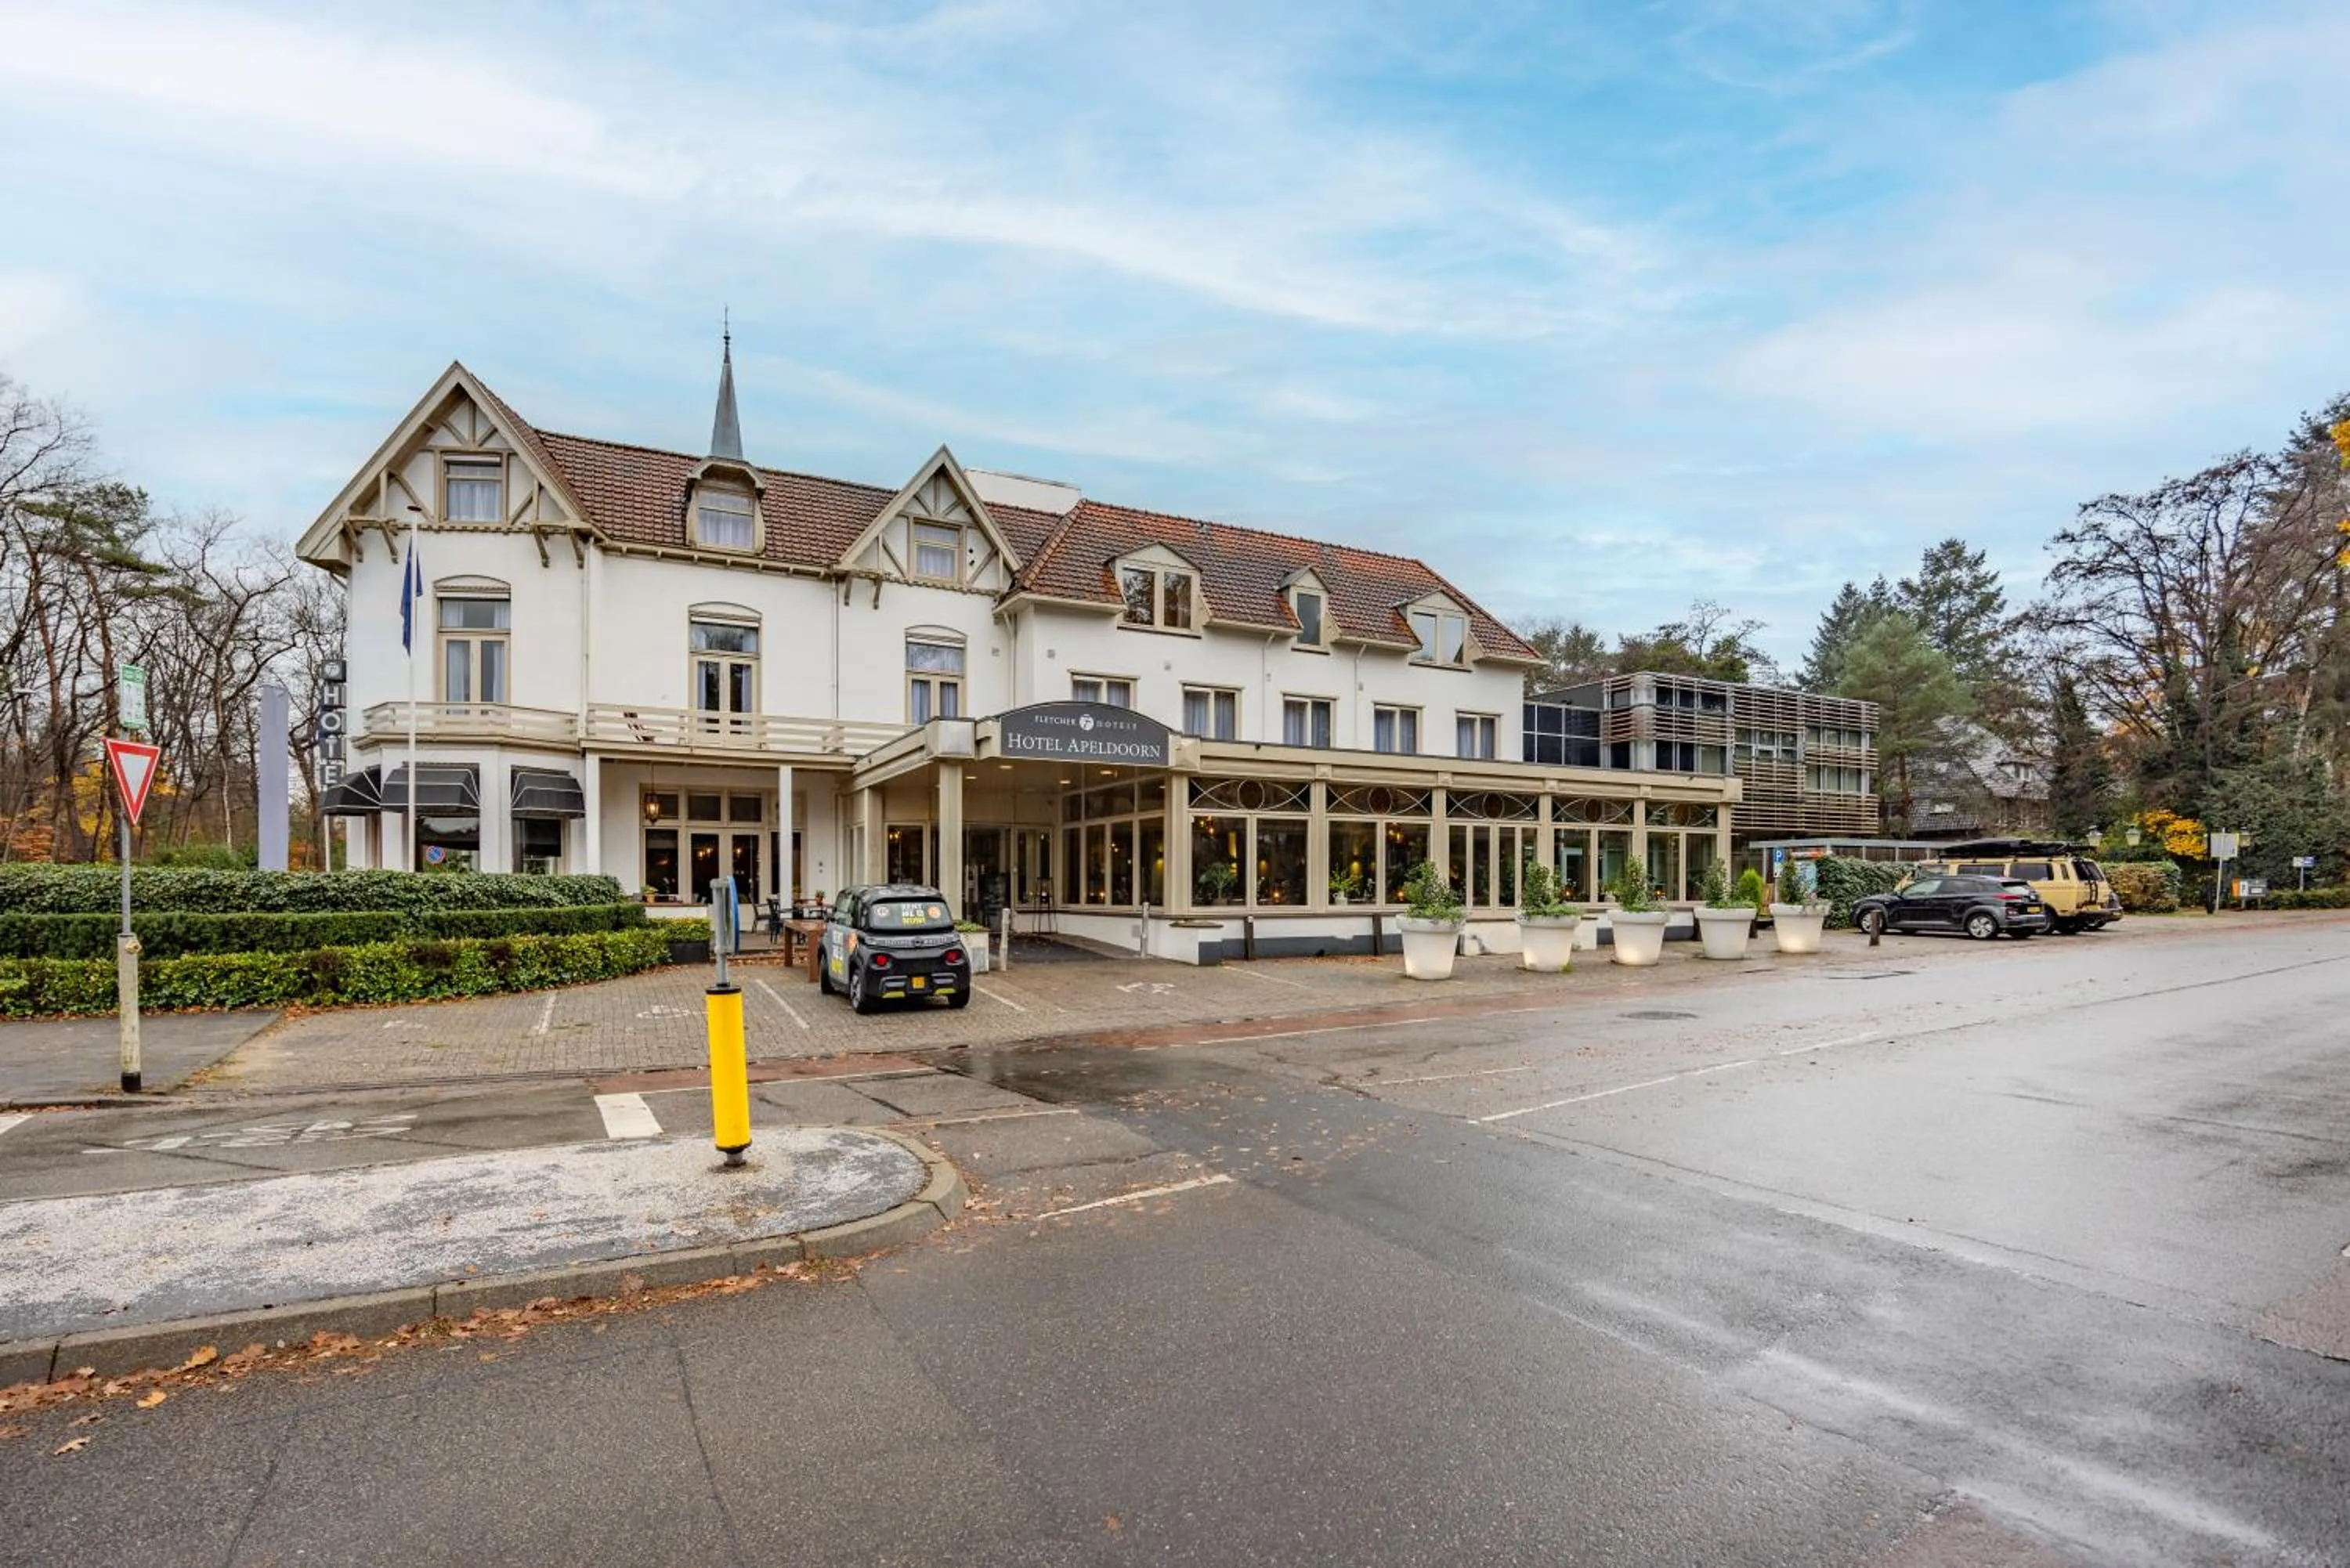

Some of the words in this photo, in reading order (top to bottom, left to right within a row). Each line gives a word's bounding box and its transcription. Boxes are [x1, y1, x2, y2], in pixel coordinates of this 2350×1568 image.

[1035, 714, 1076, 726] FLETCHER
[320, 685, 341, 786] HOTE
[1007, 732, 1063, 752] HOTEL
[1067, 738, 1161, 758] APELDOORN
[1776, 849, 1782, 862] P
